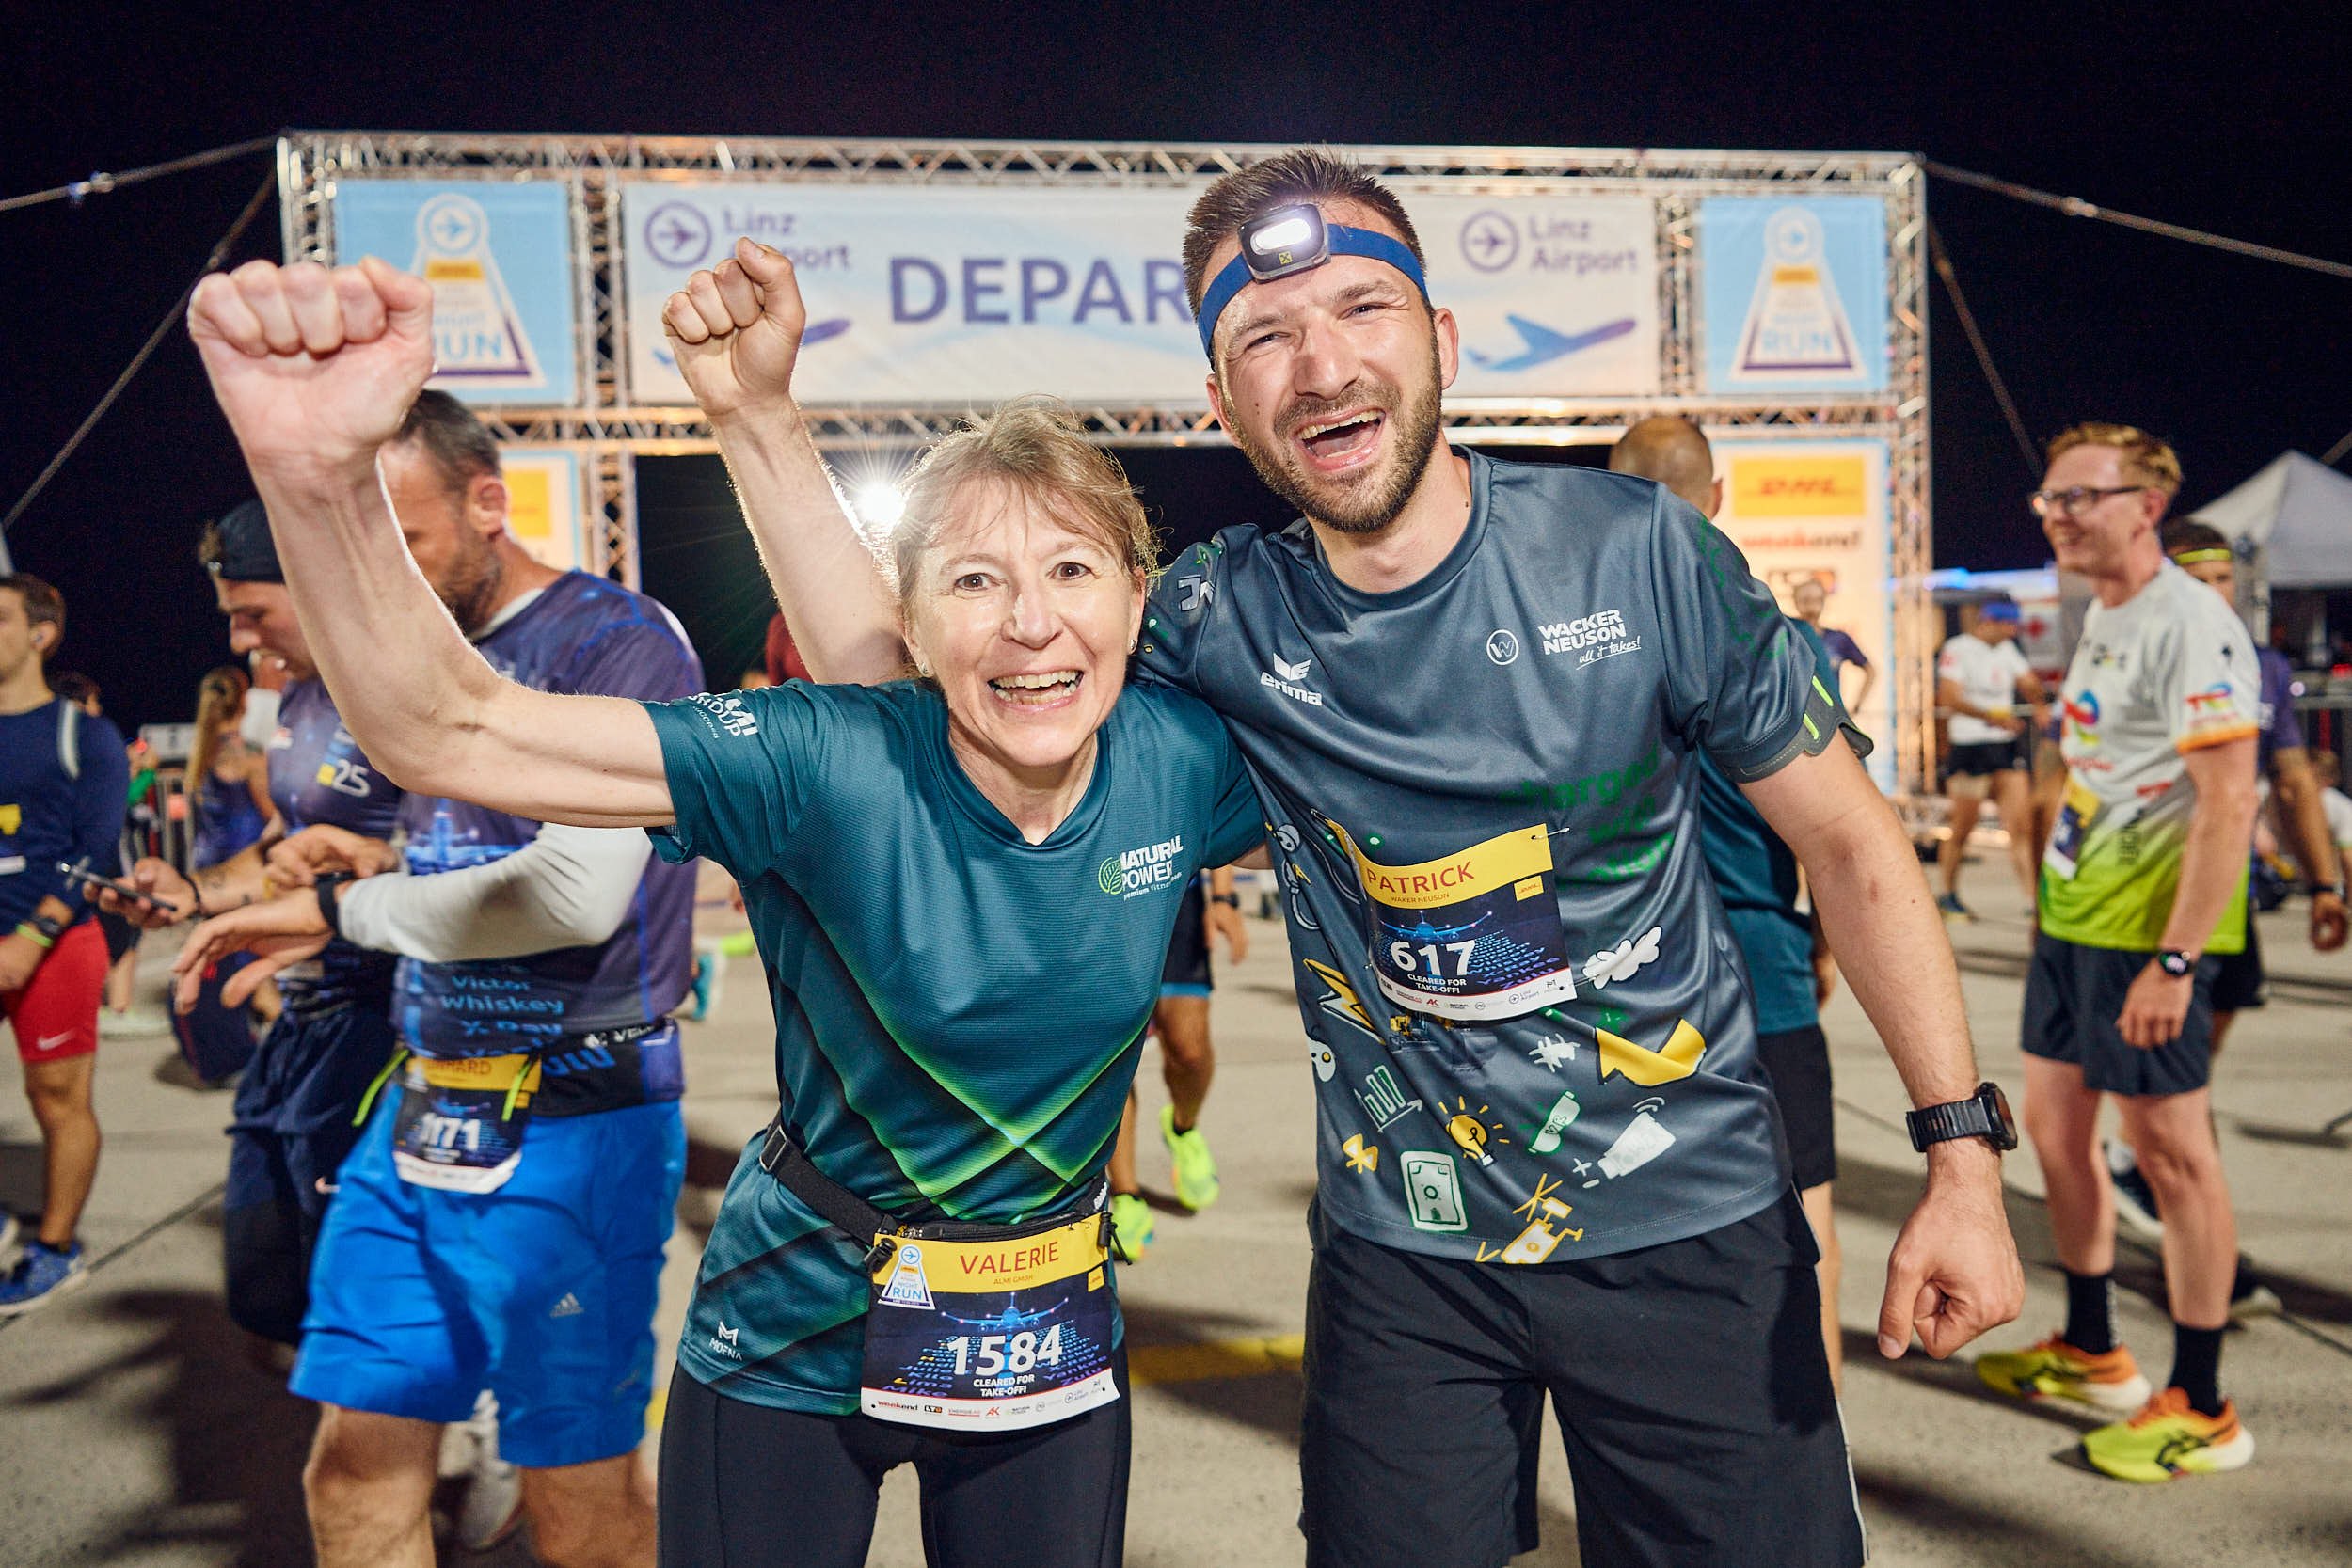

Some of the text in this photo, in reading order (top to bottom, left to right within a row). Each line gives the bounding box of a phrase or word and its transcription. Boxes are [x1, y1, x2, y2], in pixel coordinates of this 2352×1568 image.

[723, 205, 796, 234] Linz
[1527, 213, 1591, 242] Linz
[1529, 245, 1639, 277] Airport
[434, 331, 502, 360] UN
[1538, 609, 1624, 640] WACKER
[1542, 623, 1627, 656] NEUSON
[1579, 635, 1642, 664] all it takes!
[1260, 671, 1323, 706] erima
[332, 758, 371, 798] 25
[1367, 861, 1475, 894] PATRICK
[1417, 893, 1450, 903] NEUSON
[1390, 939, 1476, 976] 617
[1406, 973, 1446, 986] CLEARED
[1415, 982, 1460, 994] TAKE-OFF!
[442, 994, 564, 1016] Whiskey
[960, 1241, 1060, 1275] VALERIE
[892, 1287, 922, 1301] RUN
[946, 1323, 1064, 1377] 1584
[973, 1374, 1036, 1389] CLEARED FOR
[980, 1386, 1028, 1398] TAKE-OFF!
[877, 1400, 919, 1411] weekend
